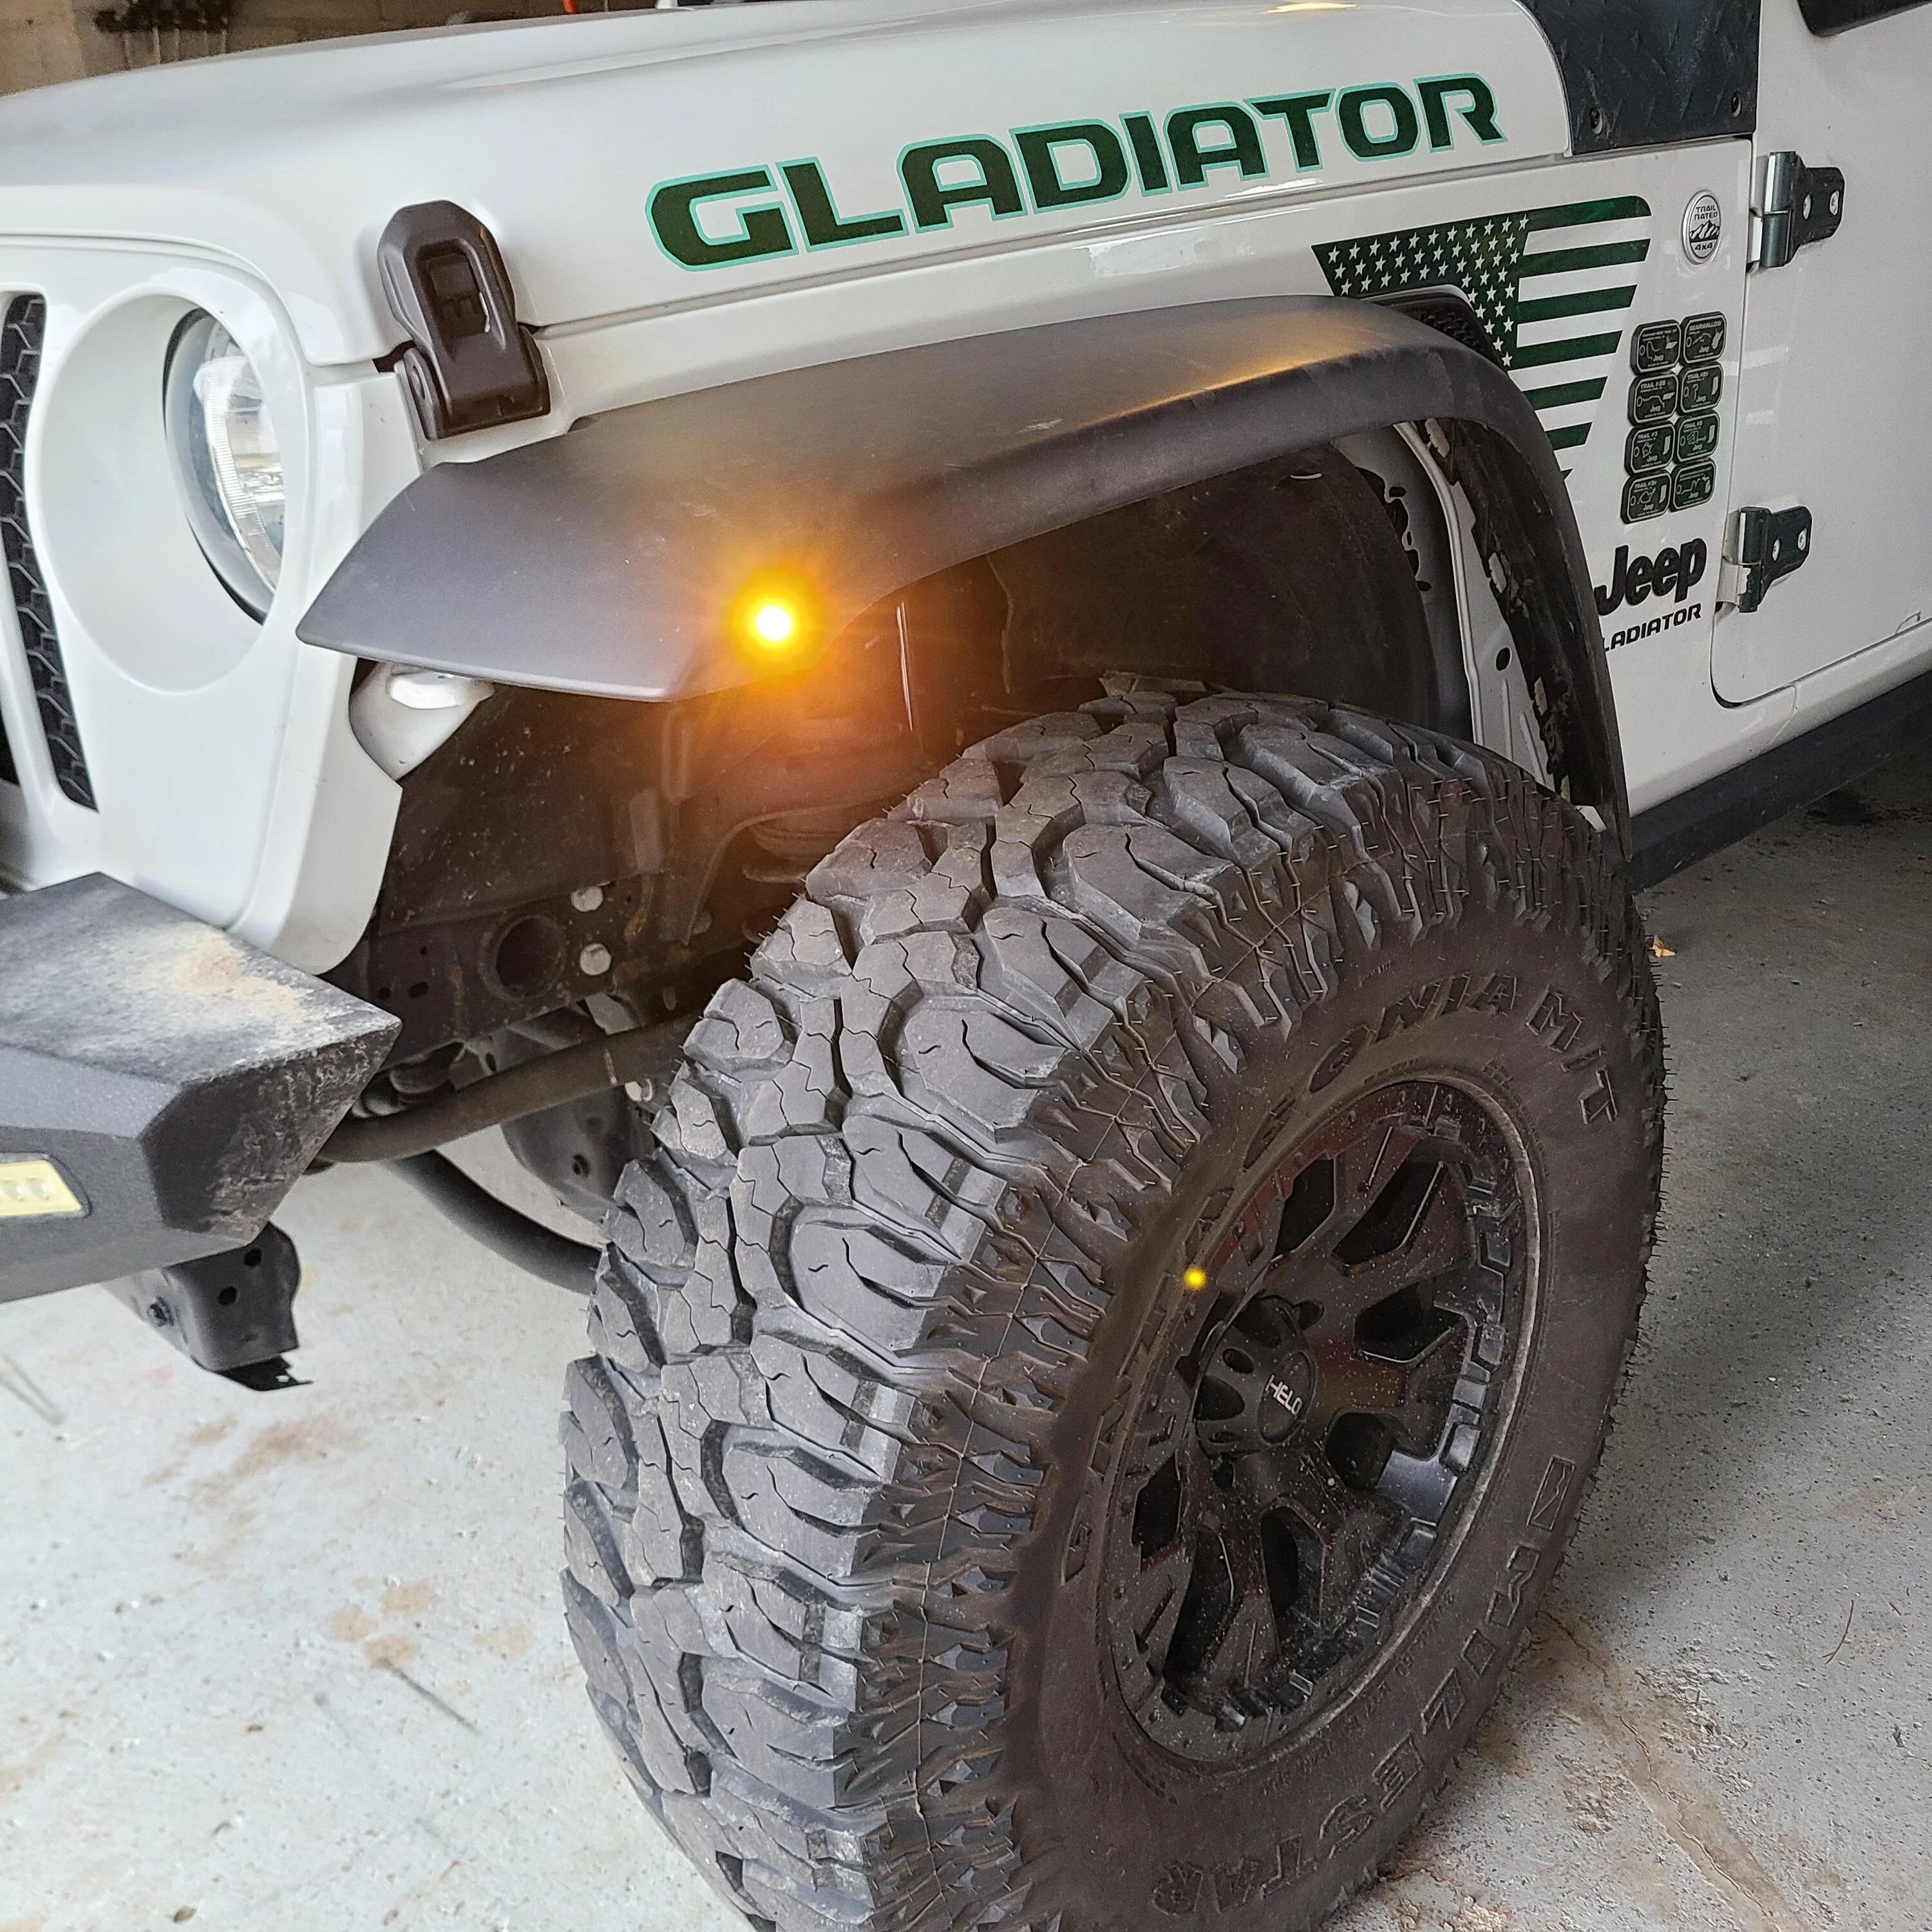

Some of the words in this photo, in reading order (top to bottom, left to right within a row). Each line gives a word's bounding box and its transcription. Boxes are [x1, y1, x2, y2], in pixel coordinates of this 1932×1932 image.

[645, 72, 1507, 272] GLADIATOR
[1694, 211, 1718, 220] RATED
[1594, 538, 1707, 616] Jeep
[1604, 603, 1701, 652] LADIATOR
[1265, 1374, 1302, 1416] HELO
